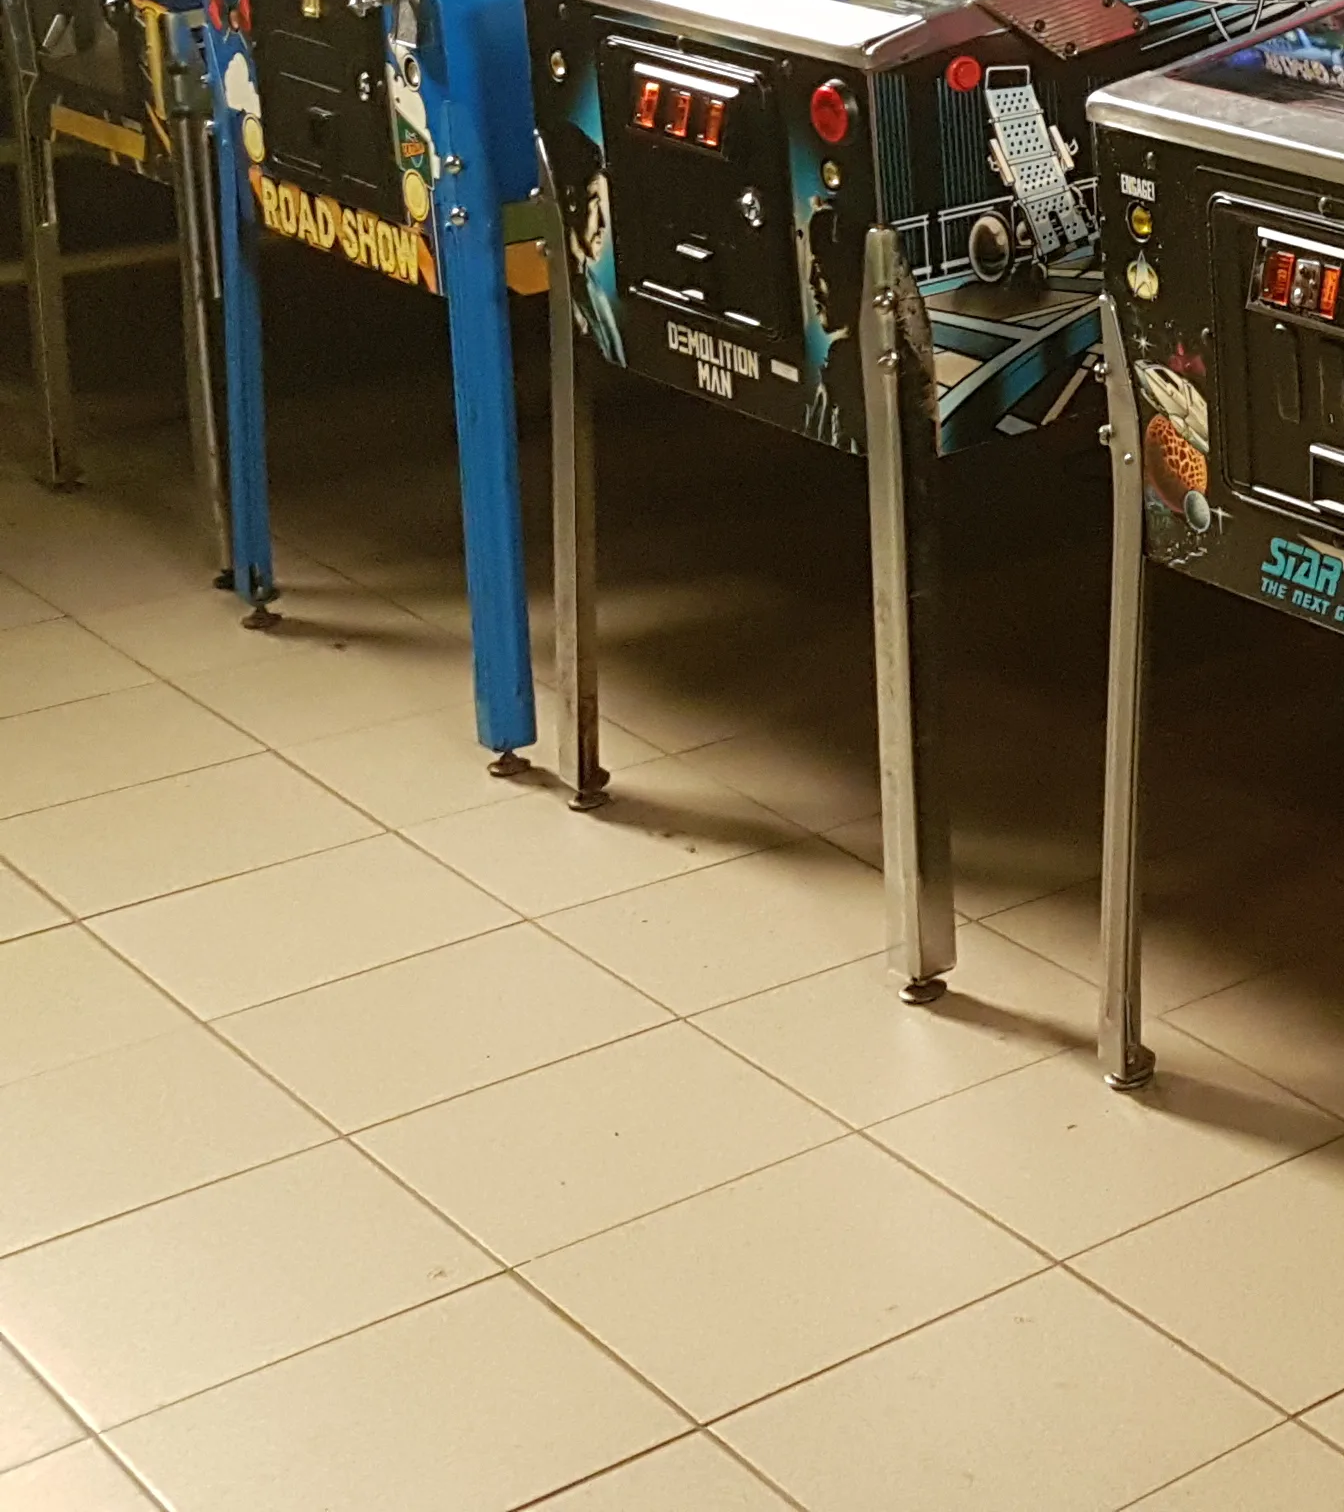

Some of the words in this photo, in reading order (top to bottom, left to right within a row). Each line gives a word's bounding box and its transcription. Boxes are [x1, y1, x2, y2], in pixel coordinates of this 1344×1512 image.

[1120, 173, 1156, 202] ENGAGE!
[259, 180, 336, 253] ROAD
[340, 207, 419, 286] SHOW
[666, 320, 760, 380] DEMOLITION
[697, 360, 733, 399] MAN
[1261, 537, 1344, 597] STAR
[1261, 576, 1288, 600] THE
[1291, 589, 1331, 616] NEXT
